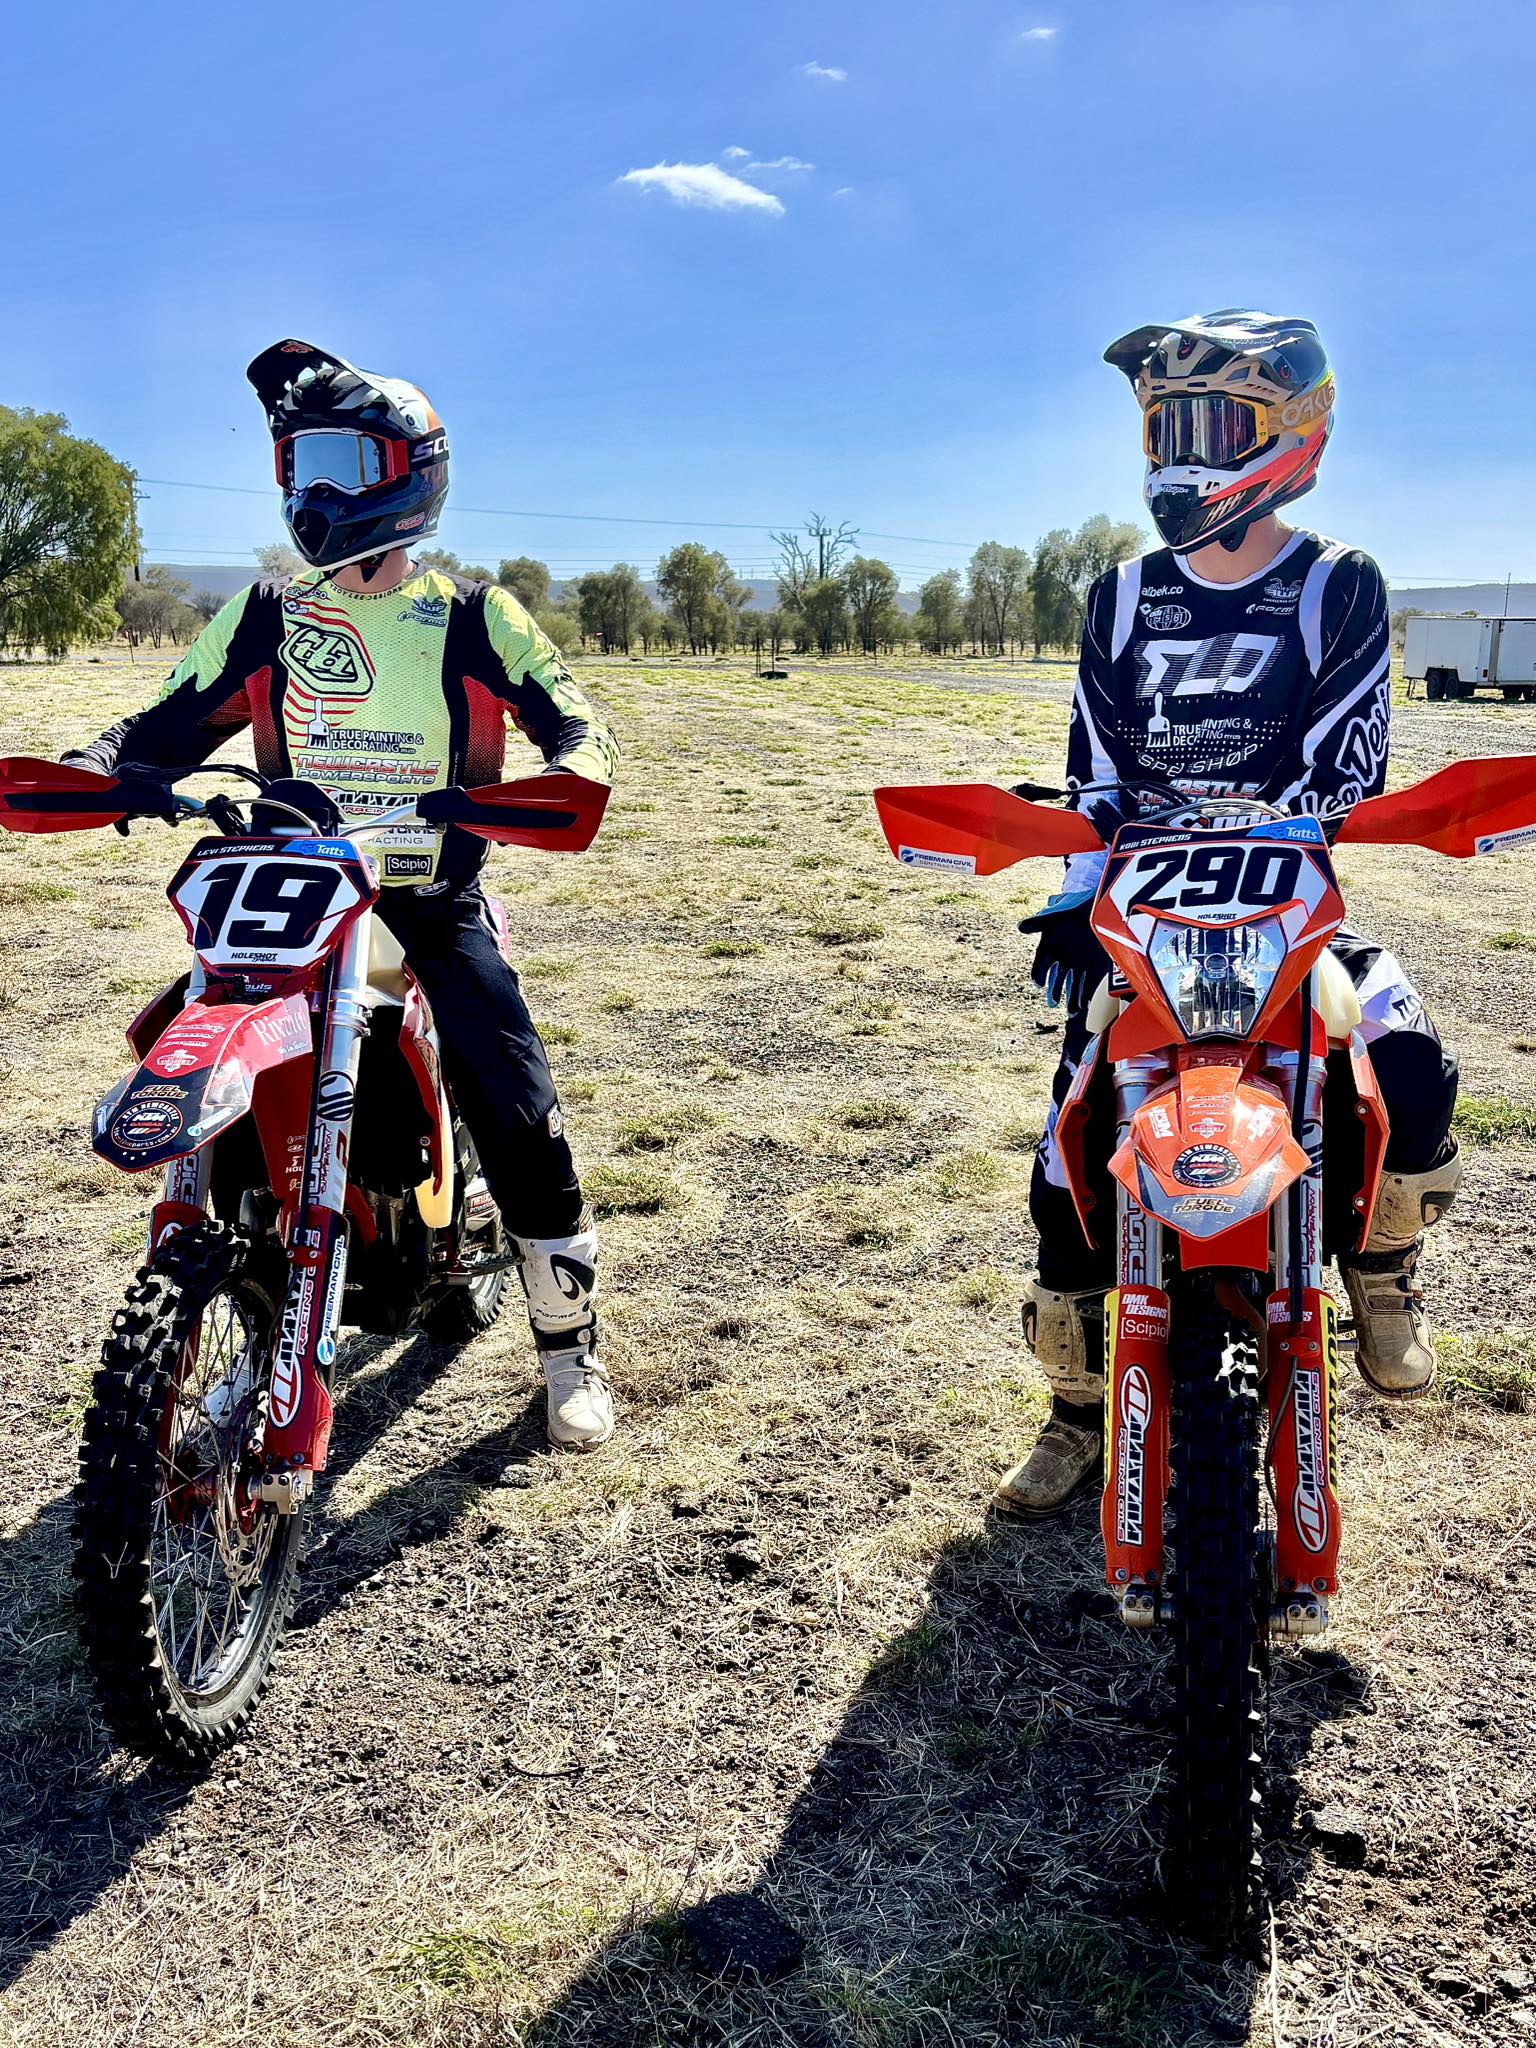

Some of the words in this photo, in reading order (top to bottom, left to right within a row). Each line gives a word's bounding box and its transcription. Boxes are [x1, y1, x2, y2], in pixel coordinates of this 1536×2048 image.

[1354, 624, 1383, 659] GRAND
[1173, 725, 1201, 735] TRUE
[1243, 718, 1252, 729] &
[331, 730, 361, 740] TRUE
[363, 731, 414, 744] PAINTING
[415, 733, 425, 745] &
[332, 740, 399, 753] DECORATING
[296, 754, 441, 775] NEWCASTLE
[296, 769, 437, 785] POWERSPORTS
[1285, 826, 1318, 840] Tatts
[1140, 834, 1192, 847] STEPHENS
[197, 848, 218, 857] LEVI
[219, 845, 275, 854] STEPHENS
[316, 844, 346, 857] Tatts
[914, 853, 952, 865] FREEMAN
[953, 859, 973, 867] CIVIL
[919, 860, 967, 871] CONTRACTING
[1127, 846, 1303, 917] 290
[195, 862, 343, 950] 19
[231, 952, 278, 960] HOLESHOT
[131, 1091, 190, 1099] TORQUE
[143, 1084, 181, 1092] FUEL
[132, 1112, 167, 1121] KTM
[1189, 1153, 1225, 1163] KTM
[1185, 1198, 1225, 1206] FUEL
[1173, 1205, 1236, 1214] TORQUE
[322, 1268, 339, 1338] FREEMAN
[334, 1235, 345, 1269] CIVIL
[1121, 1293, 1150, 1305] DMK
[296, 1280, 315, 1355] RACING
[1125, 1304, 1168, 1318] DESIGNS
[1311, 1371, 1321, 1415] OILS
[1313, 1418, 1326, 1488] RACING
[1116, 1427, 1127, 1496] RACING
[1117, 1498, 1126, 1541] OILS
